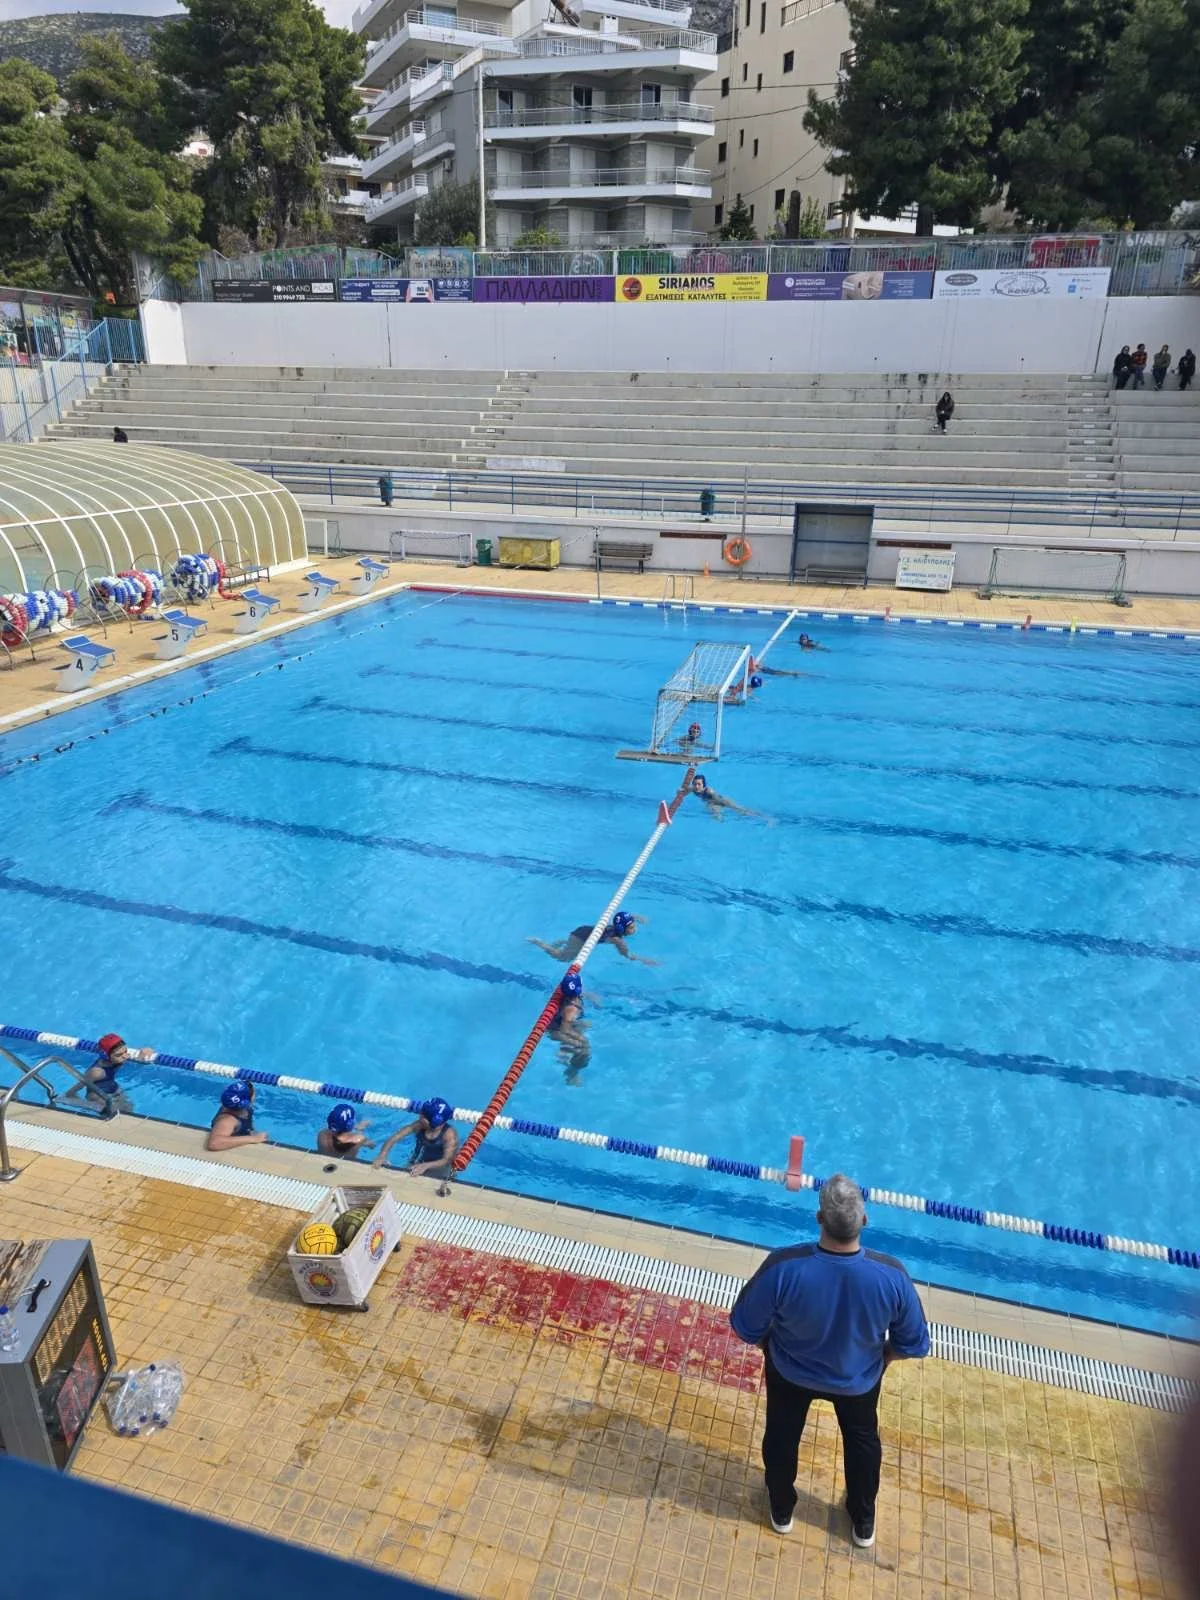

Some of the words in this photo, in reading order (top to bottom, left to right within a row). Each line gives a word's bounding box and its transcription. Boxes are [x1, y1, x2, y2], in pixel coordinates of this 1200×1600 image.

[658, 277, 715, 289] SIRIANOS
[365, 571, 371, 581] 8
[313, 587, 319, 597] 7
[249, 606, 256, 617] 6
[171, 629, 179, 641] 5
[75, 658, 84, 672] 4
[568, 981, 576, 990] 6
[438, 1103, 446, 1114] 7
[340, 1109, 352, 1121] 11
